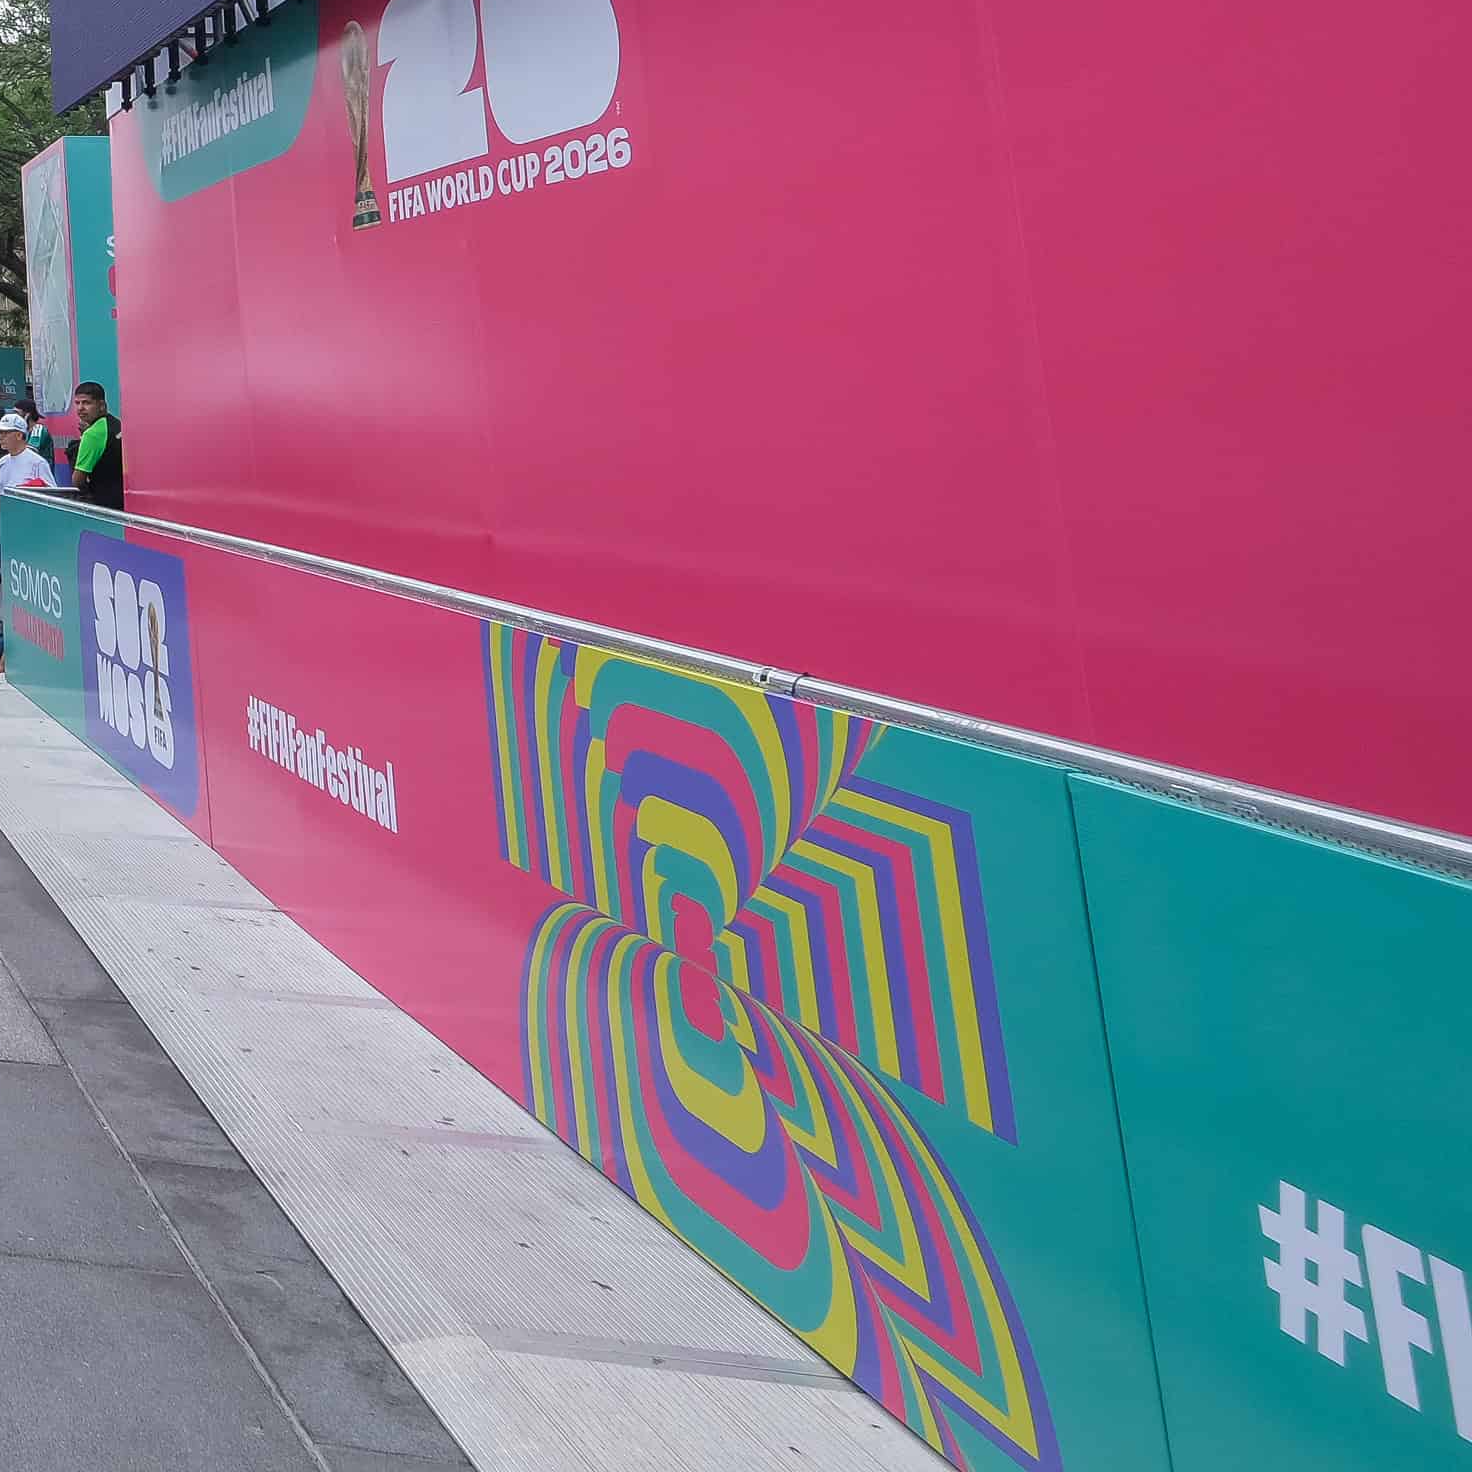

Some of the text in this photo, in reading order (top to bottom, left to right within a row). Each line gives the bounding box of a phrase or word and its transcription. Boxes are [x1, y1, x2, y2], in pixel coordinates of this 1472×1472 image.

[160, 56, 275, 169] #FIFAFanFestival
[387, 127, 633, 223] FIFA WORLD CUP 2026
[10, 558, 63, 620] SOMOS
[153, 725, 168, 751] FIFA
[246, 694, 399, 835] #FIFAFanFestival
